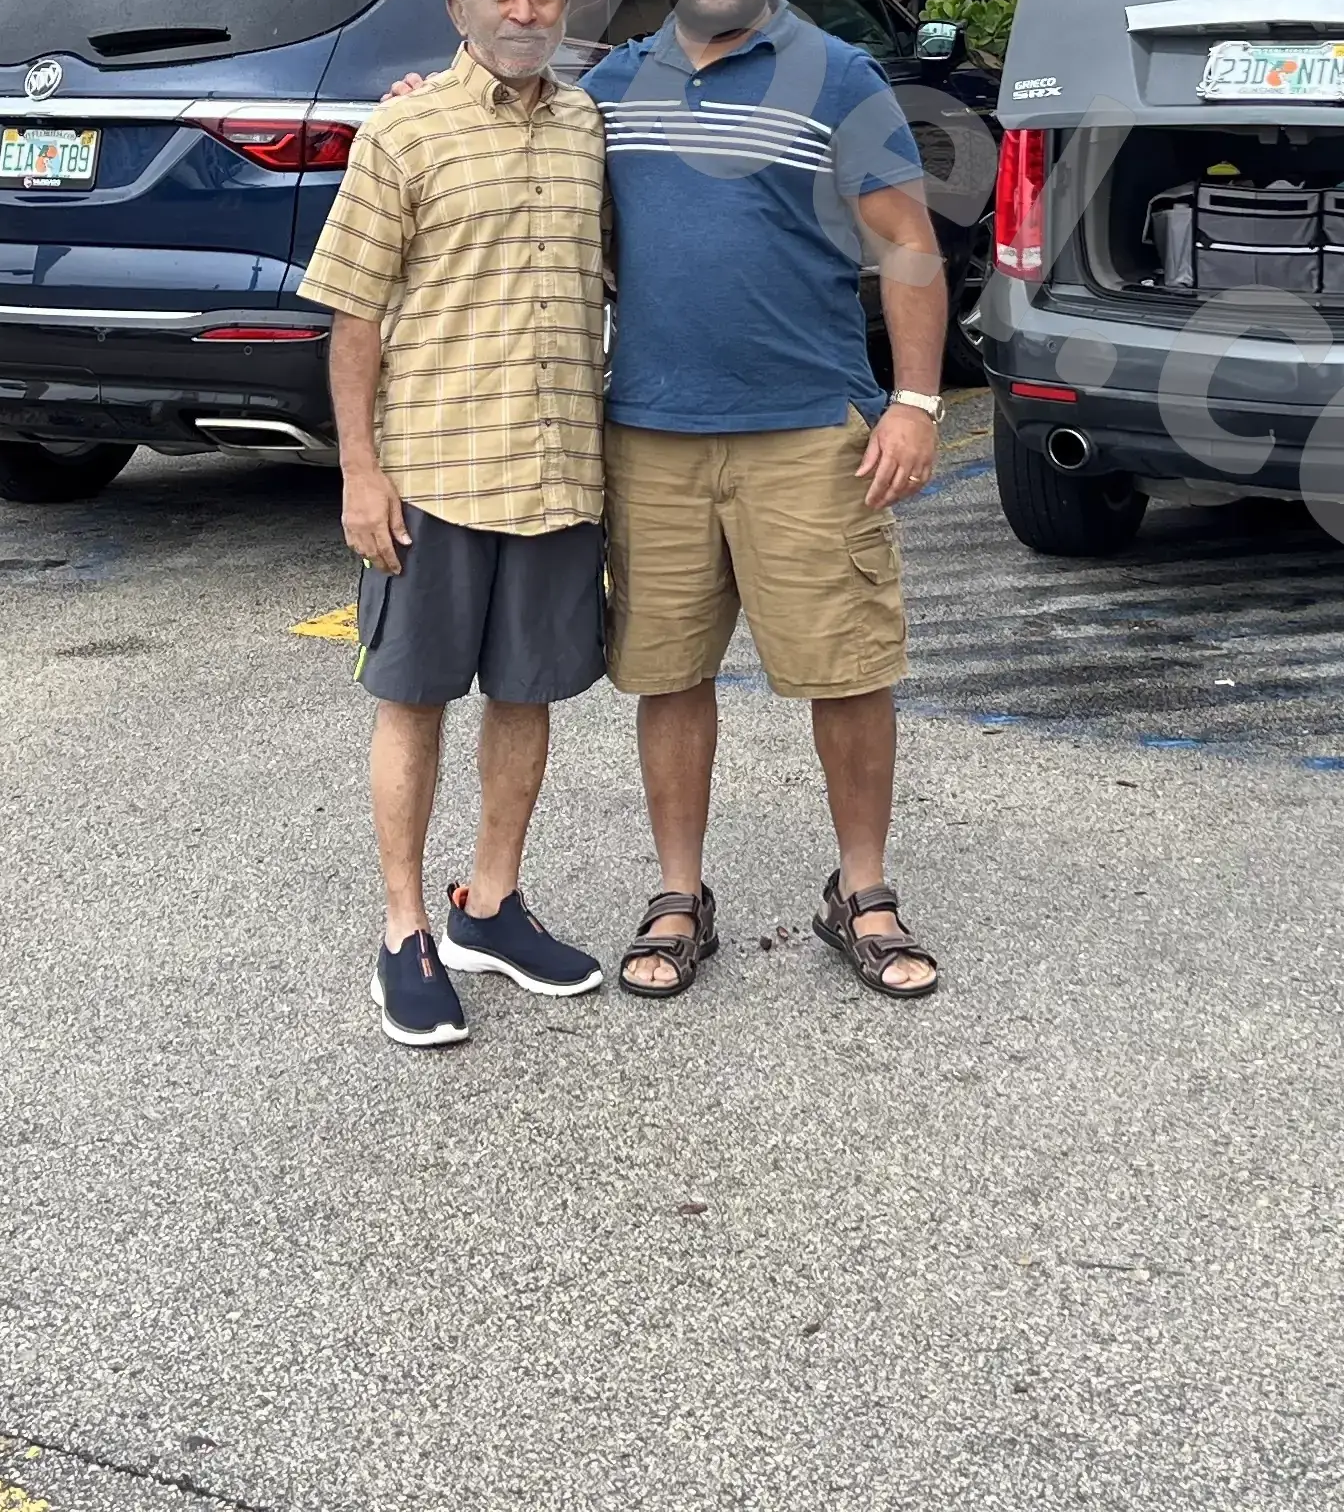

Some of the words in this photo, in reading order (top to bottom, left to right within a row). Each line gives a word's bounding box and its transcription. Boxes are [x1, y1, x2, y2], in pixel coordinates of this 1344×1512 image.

[1012, 87, 1063, 100] SRX
[2, 142, 34, 171] EIA
[59, 143, 91, 173] T89
